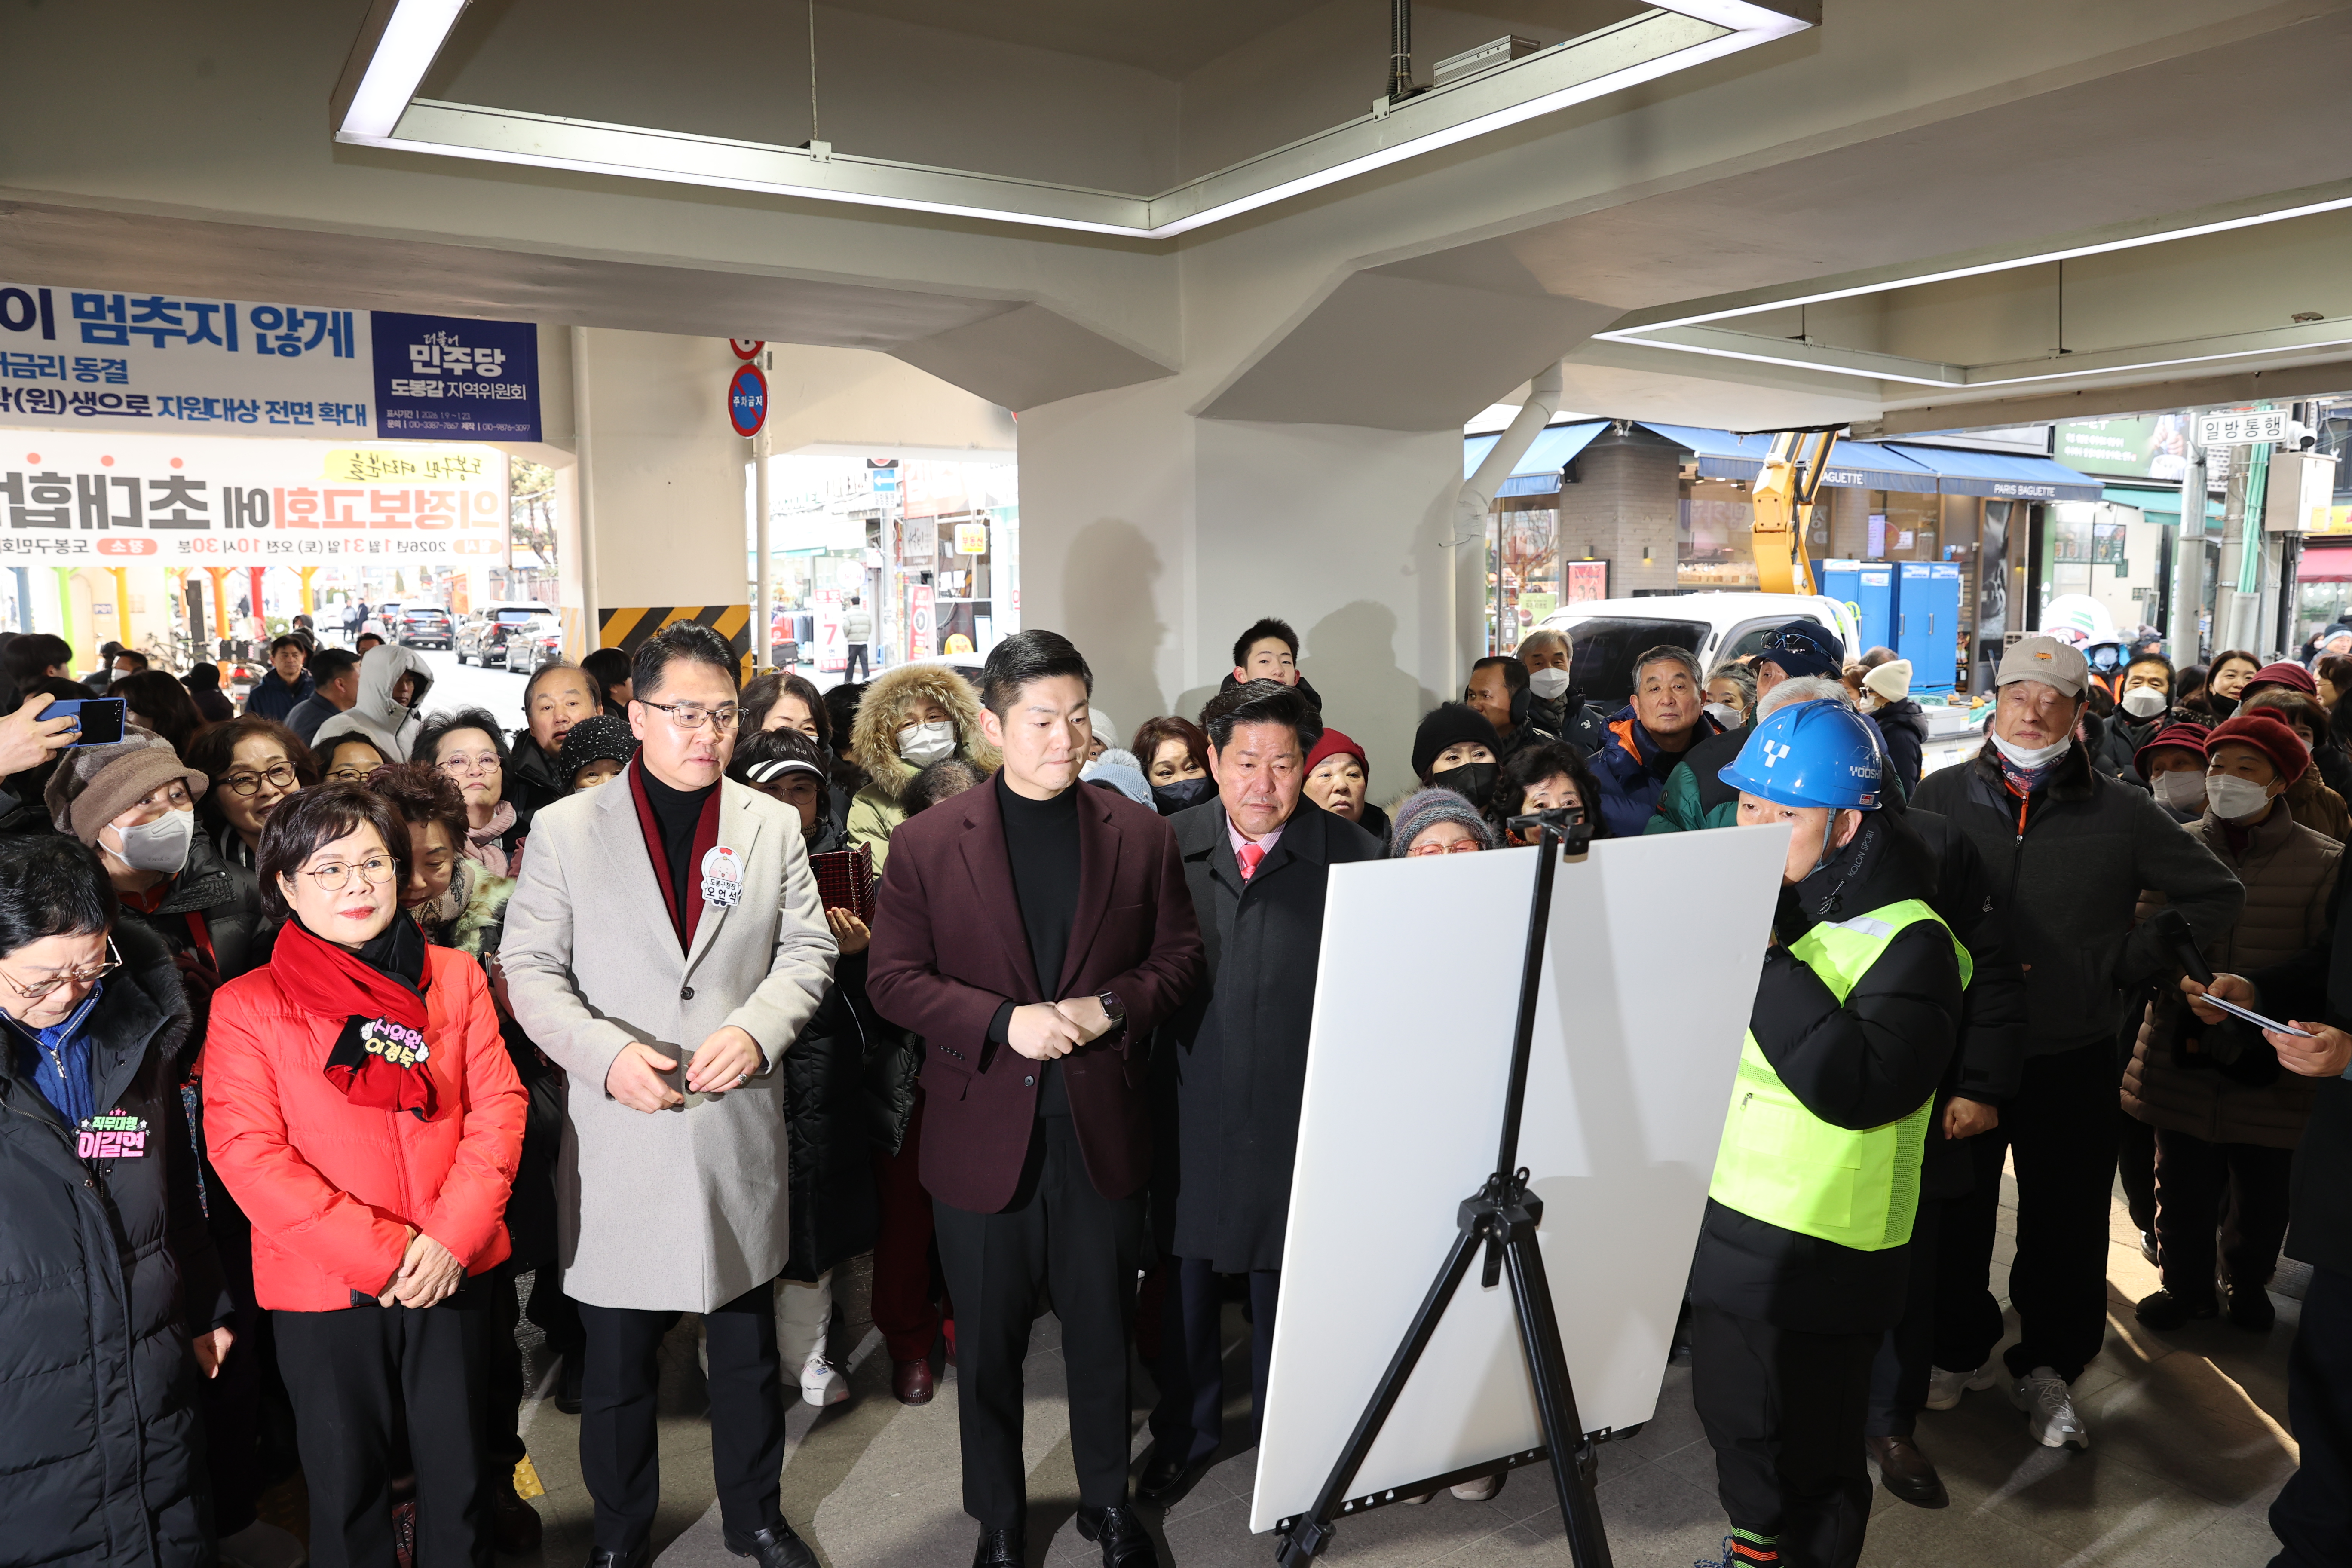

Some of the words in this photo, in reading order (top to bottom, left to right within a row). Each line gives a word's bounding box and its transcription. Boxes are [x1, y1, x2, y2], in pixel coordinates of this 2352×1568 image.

[71, 292, 239, 352] 멈추지
[250, 305, 355, 358] 않게
[423, 330, 459, 347] 더불어
[72, 355, 129, 385] 동결
[409, 344, 506, 378] 민주당
[391, 379, 444, 398] 도봉갑
[447, 381, 527, 401] 지역위원회
[156, 395, 260, 424] 지원대상
[265, 400, 313, 426] 전면
[318, 402, 368, 427] 확대
[733, 395, 763, 407] 주차금지
[386, 420, 401, 429] 문의
[2206, 416, 2281, 441] 일방통행
[1821, 471, 1864, 485] AGUETTE
[1994, 484, 2017, 495] PARIS
[2018, 485, 2055, 497] BAGUETTE
[962, 536, 983, 547] 부동산
[816, 591, 840, 603] 로또
[824, 624, 837, 645] 7
[829, 649, 835, 657] 번
[1847, 851, 1866, 877] KOLON
[1861, 829, 1875, 851] SPORT
[710, 879, 736, 890] 도봉구청장
[373, 1018, 422, 1050] 시의원
[365, 1038, 415, 1068] 이경숙
[92, 1116, 138, 1131] 직무대행
[78, 1131, 145, 1158] 이길연
